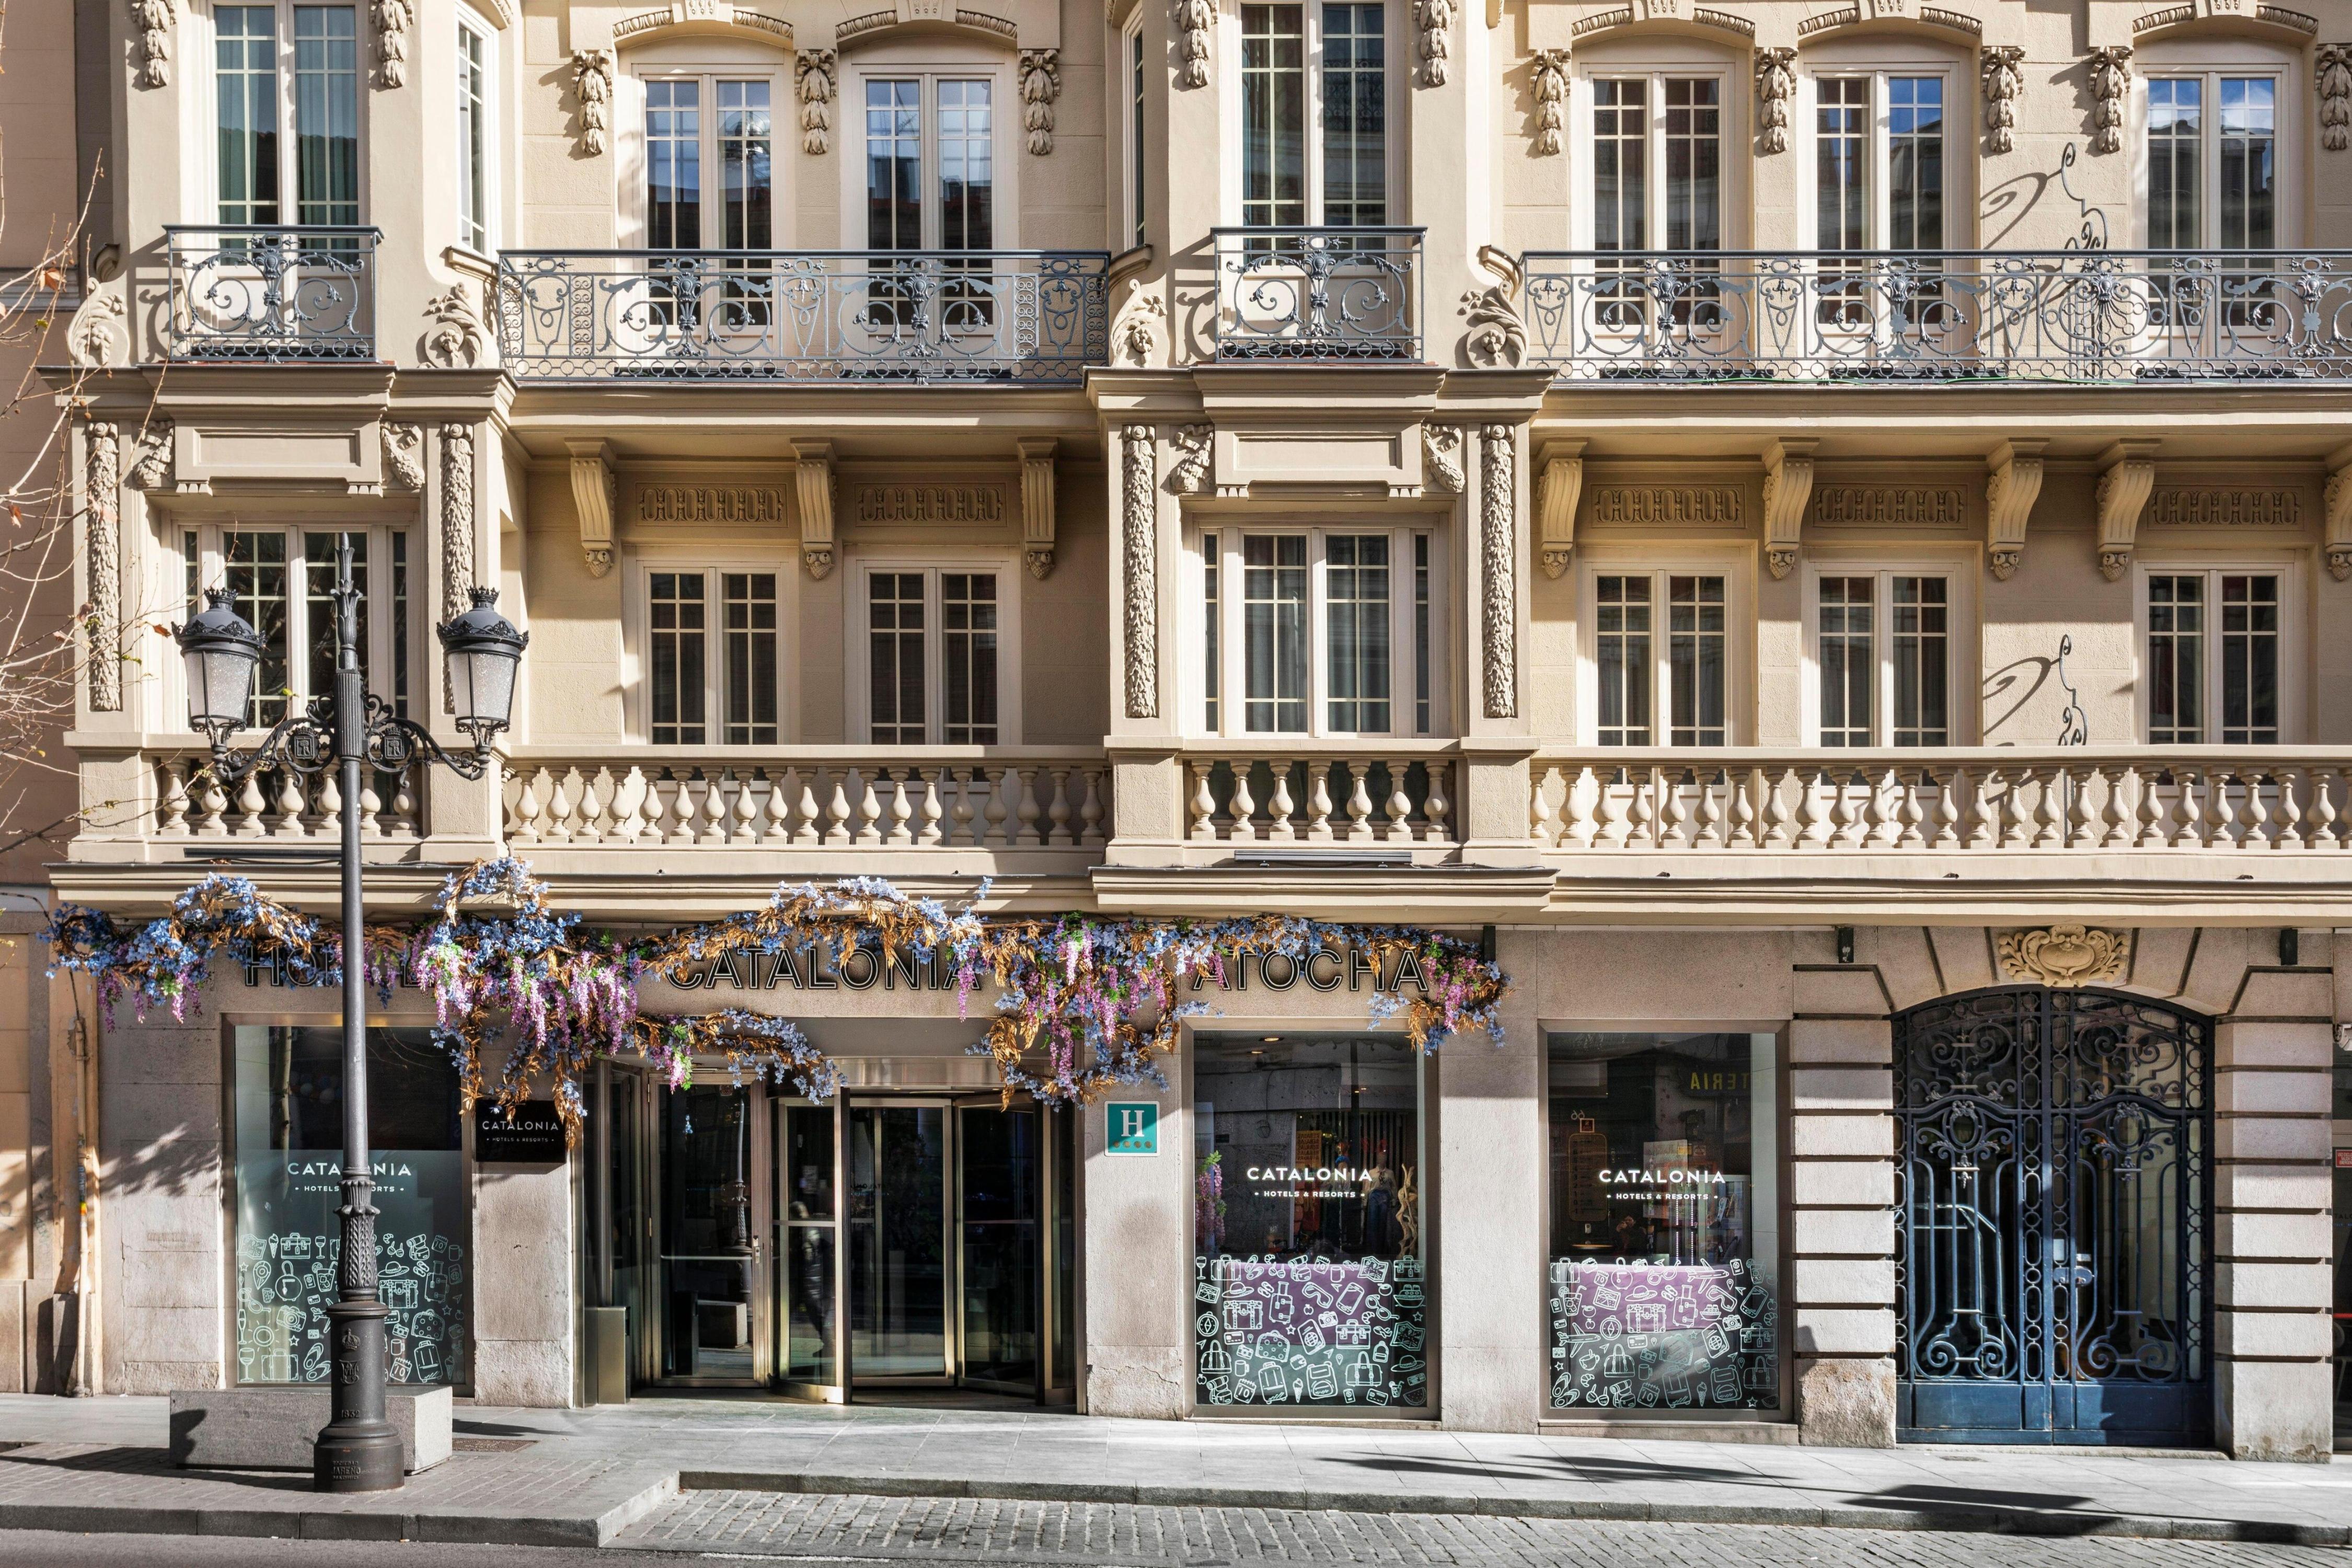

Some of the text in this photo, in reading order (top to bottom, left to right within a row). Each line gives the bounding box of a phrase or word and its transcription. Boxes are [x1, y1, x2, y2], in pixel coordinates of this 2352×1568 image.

[482, 1121, 559, 1131] CATALONIA
[1121, 1110, 1145, 1137] H
[287, 1162, 412, 1176] CATANIA
[1247, 1167, 1373, 1181] CATALONIA
[1599, 1170, 1725, 1184] CATALONIA
[394, 1365, 406, 1377] 10
[1238, 1387, 1250, 1398] 10
[1642, 1390, 1653, 1402] 10
